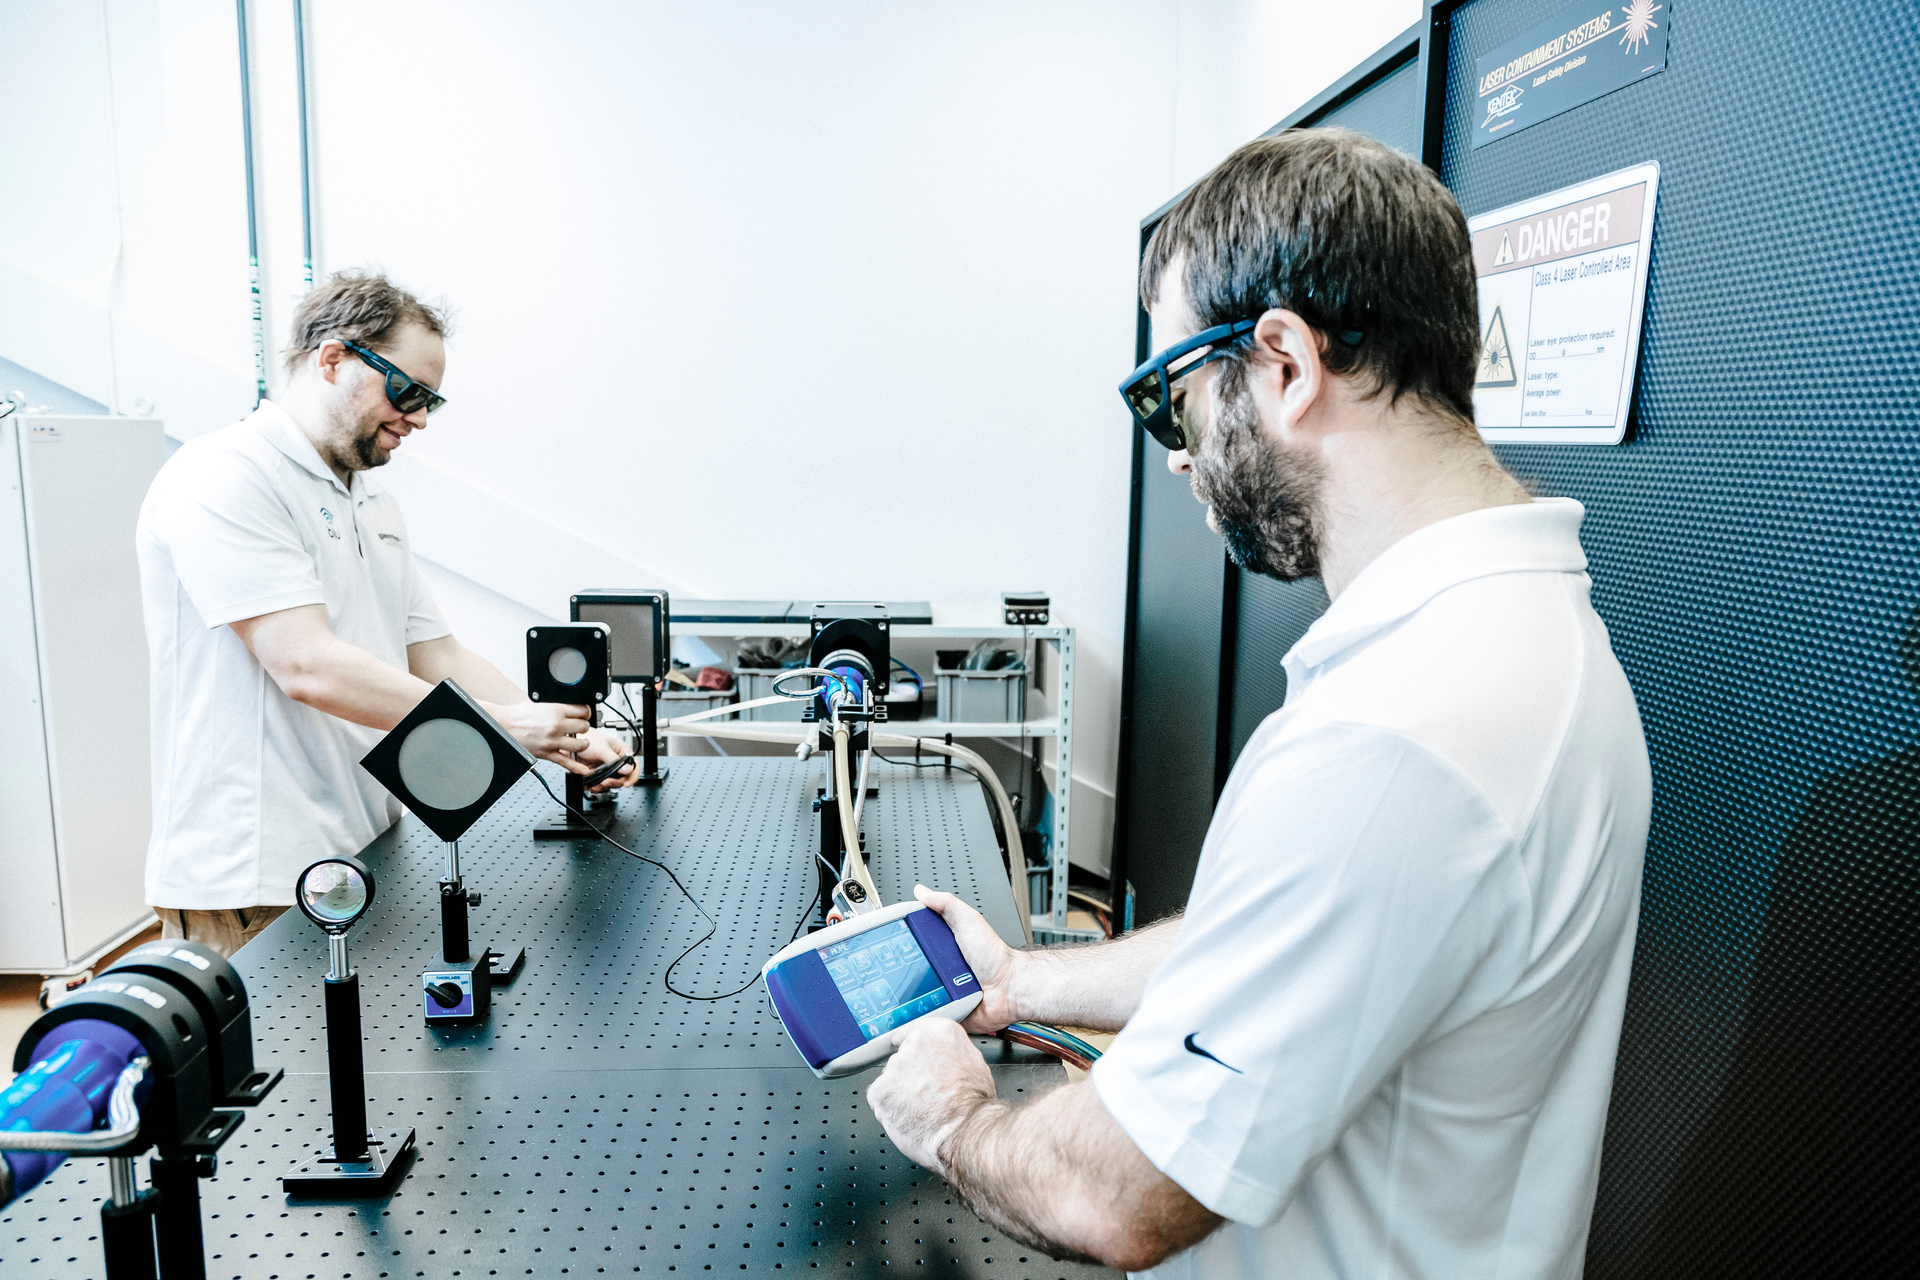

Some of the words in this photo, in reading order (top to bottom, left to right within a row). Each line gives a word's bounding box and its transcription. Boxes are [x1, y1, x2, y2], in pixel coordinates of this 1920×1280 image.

[1479, 66, 1505, 93] LASER
[1506, 33, 1568, 80] CONTAINMENT
[1565, 11, 1612, 50] SYSTEMS
[1532, 73, 1548, 87] Laser
[1547, 65, 1565, 81] Safety
[1564, 55, 1587, 73] Division
[1517, 202, 1611, 262] DANGER
[1535, 271, 1551, 287] Class
[1553, 267, 1558, 283] 4
[1560, 266, 1577, 282] Laser
[1580, 254, 1613, 278] Controlled
[1614, 253, 1631, 271] Area
[1530, 339, 1545, 347] Laser
[1547, 337, 1557, 346] eye
[1559, 333, 1588, 345] protection
[1590, 329, 1615, 340] required:
[1528, 372, 1543, 381] Laser
[1545, 372, 1558, 380] type:
[1526, 390, 1544, 398] Average
[830, 942, 850, 956] HOME
